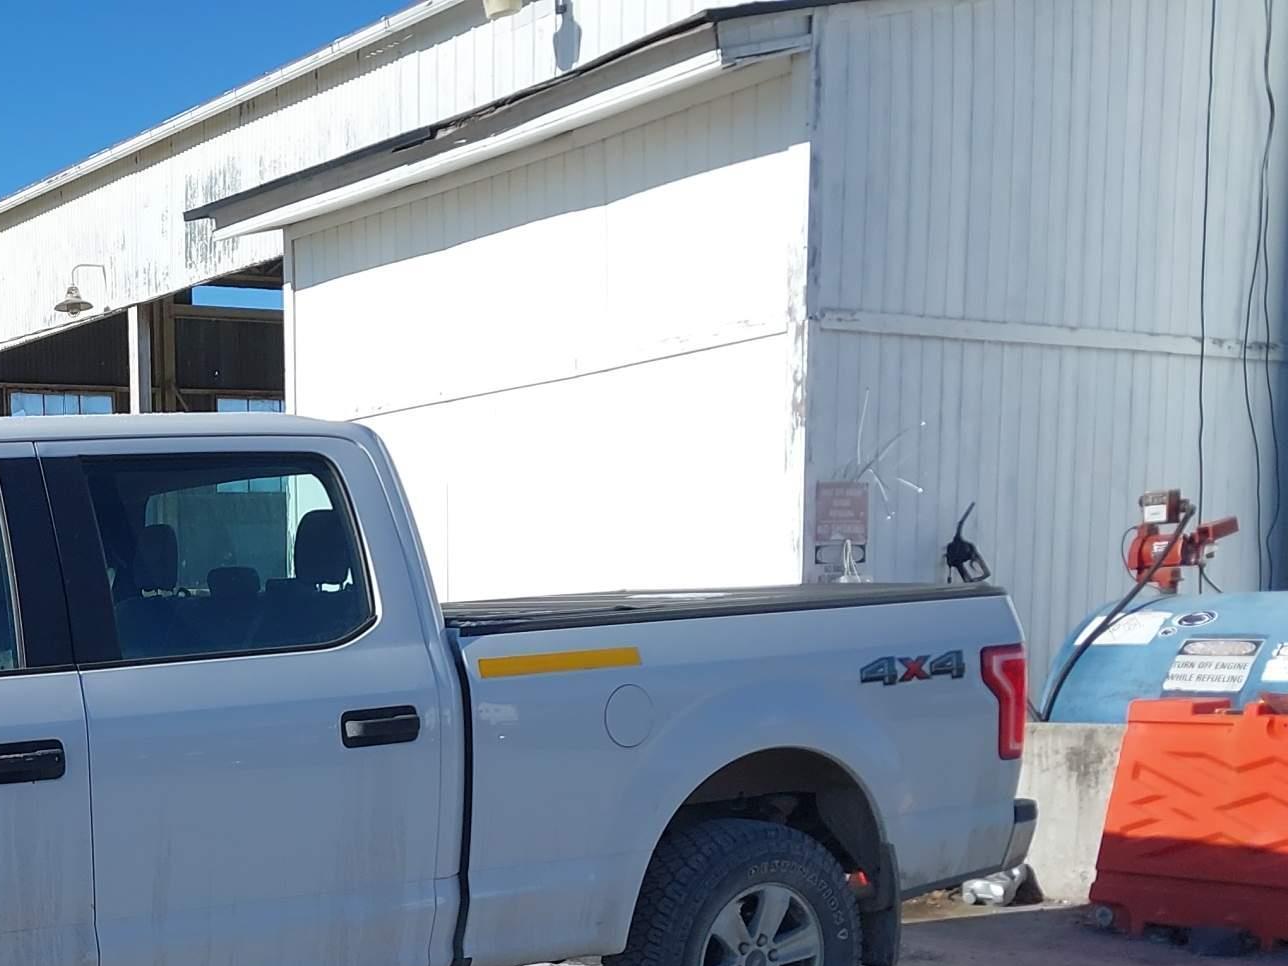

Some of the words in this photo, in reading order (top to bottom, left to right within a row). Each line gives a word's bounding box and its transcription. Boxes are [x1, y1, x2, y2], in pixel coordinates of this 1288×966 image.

[1175, 661, 1195, 670] TURN
[1197, 661, 1212, 670] OFF
[1214, 662, 1249, 670] ENGINE
[1168, 673, 1193, 682] WHILE
[1195, 673, 1244, 683] REFUELING
